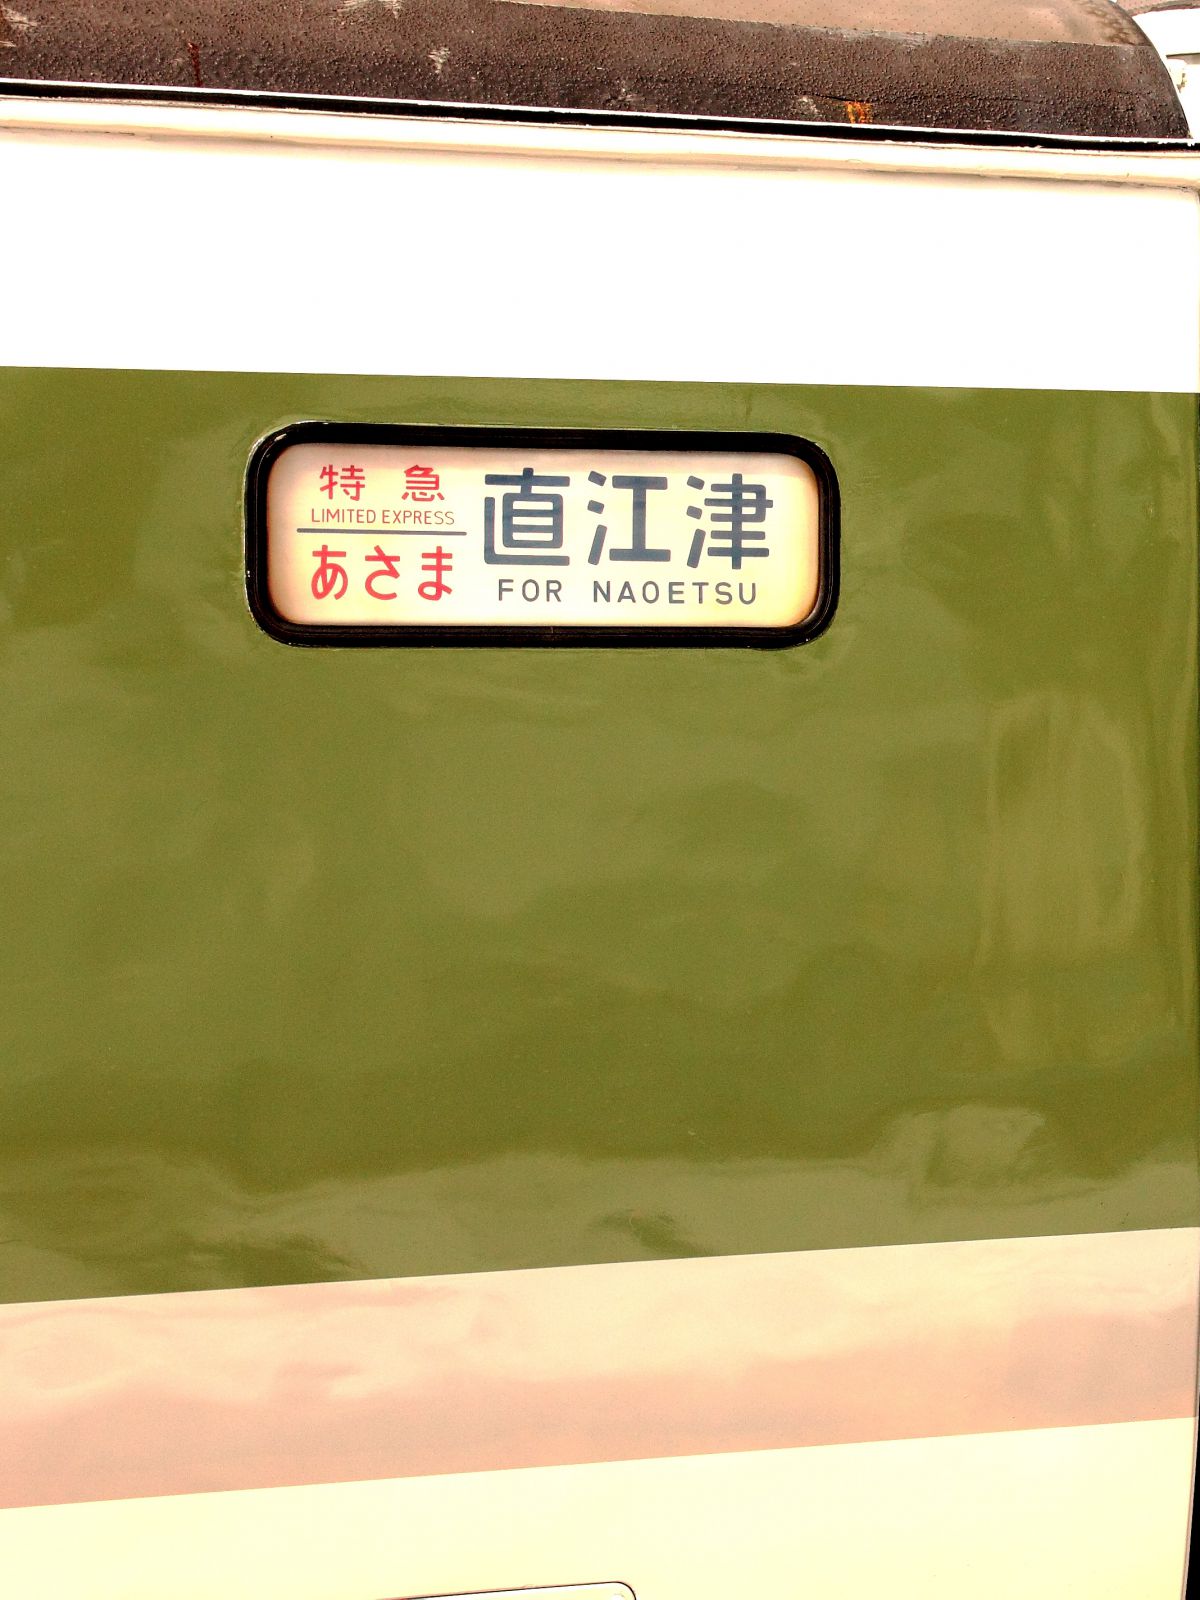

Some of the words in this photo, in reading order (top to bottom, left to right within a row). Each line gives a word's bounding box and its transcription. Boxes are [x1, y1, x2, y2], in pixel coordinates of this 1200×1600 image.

[319, 464, 446, 502] 特急
[311, 508, 377, 524] LIMITED
[381, 509, 455, 526] EXPRESS
[483, 467, 774, 571] 直江津
[311, 544, 454, 602] あさま
[498, 578, 563, 603] FOR
[593, 580, 757, 606] NAOETSU
